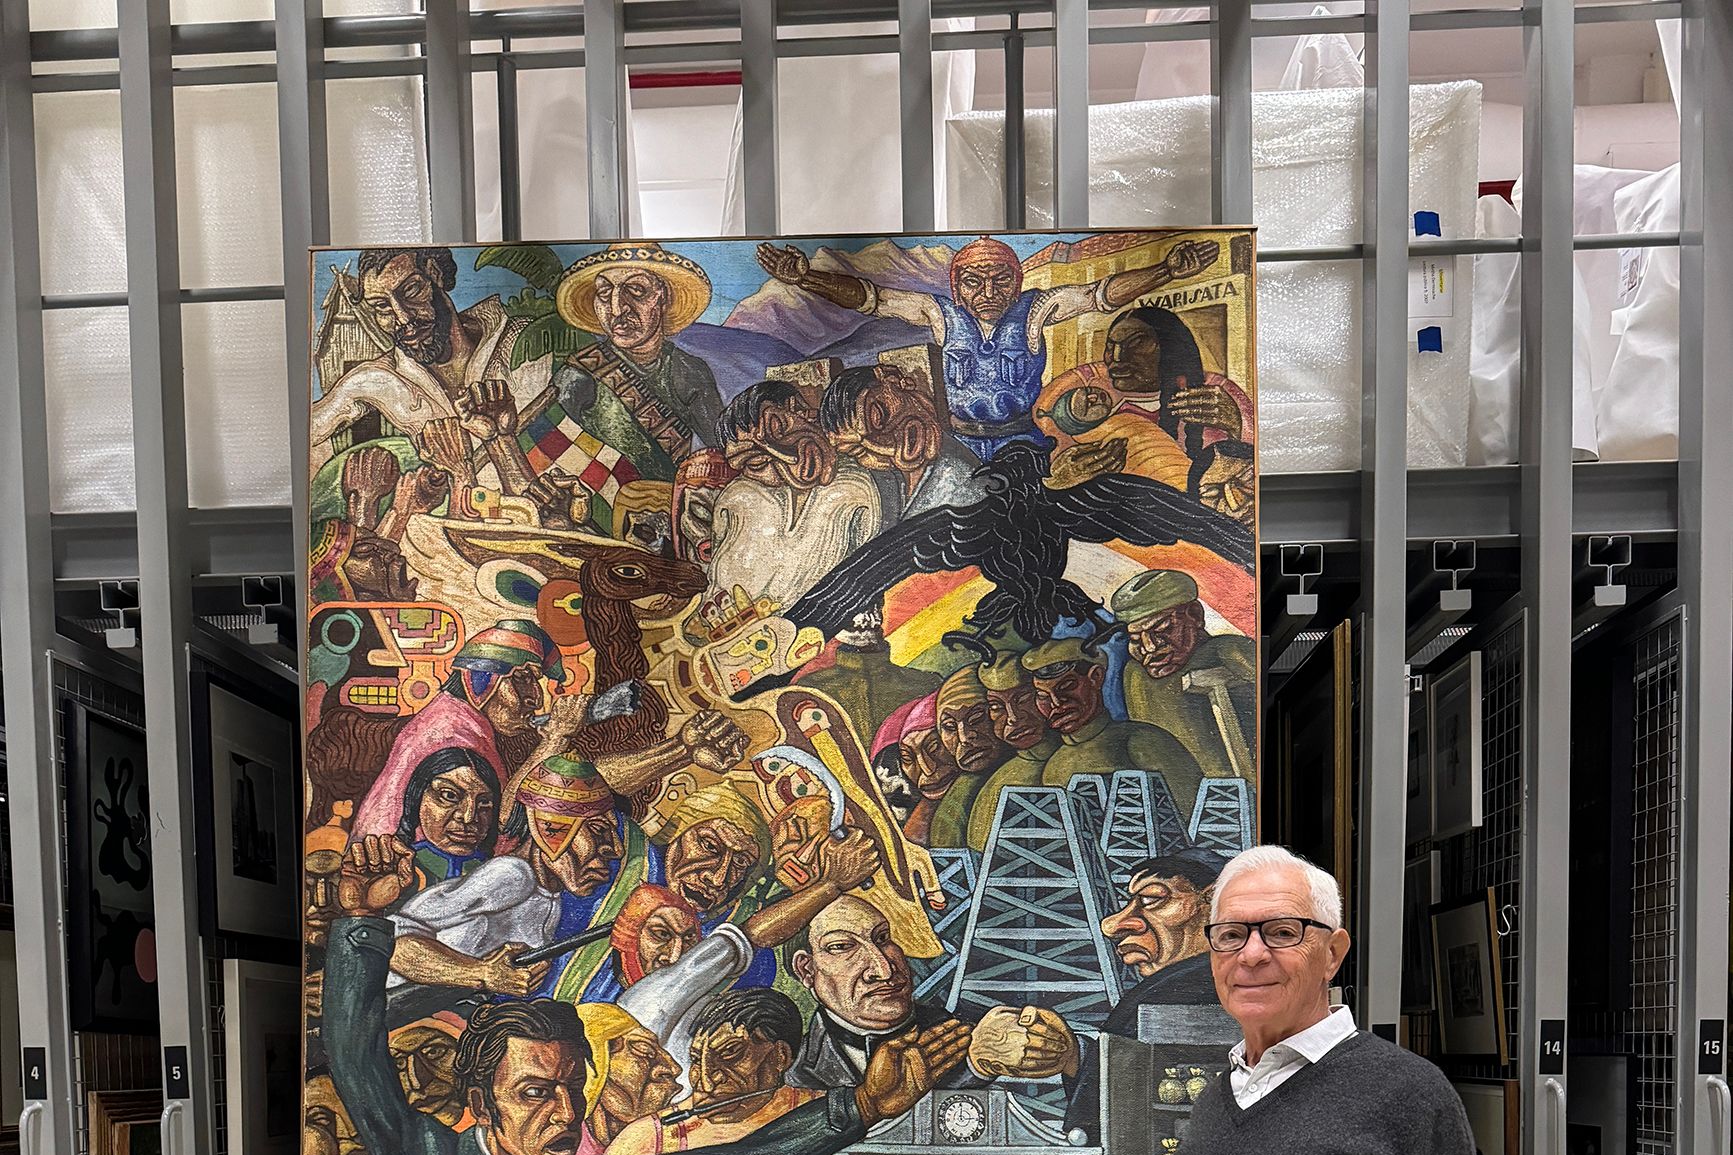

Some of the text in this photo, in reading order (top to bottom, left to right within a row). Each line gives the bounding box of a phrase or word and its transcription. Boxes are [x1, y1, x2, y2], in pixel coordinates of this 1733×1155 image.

[1138, 281, 1239, 309] WARISATA
[1544, 1040, 1561, 1055] 14
[1703, 1040, 1720, 1055] 15
[31, 1066, 39, 1080] 4
[172, 1066, 181, 1080] 5
